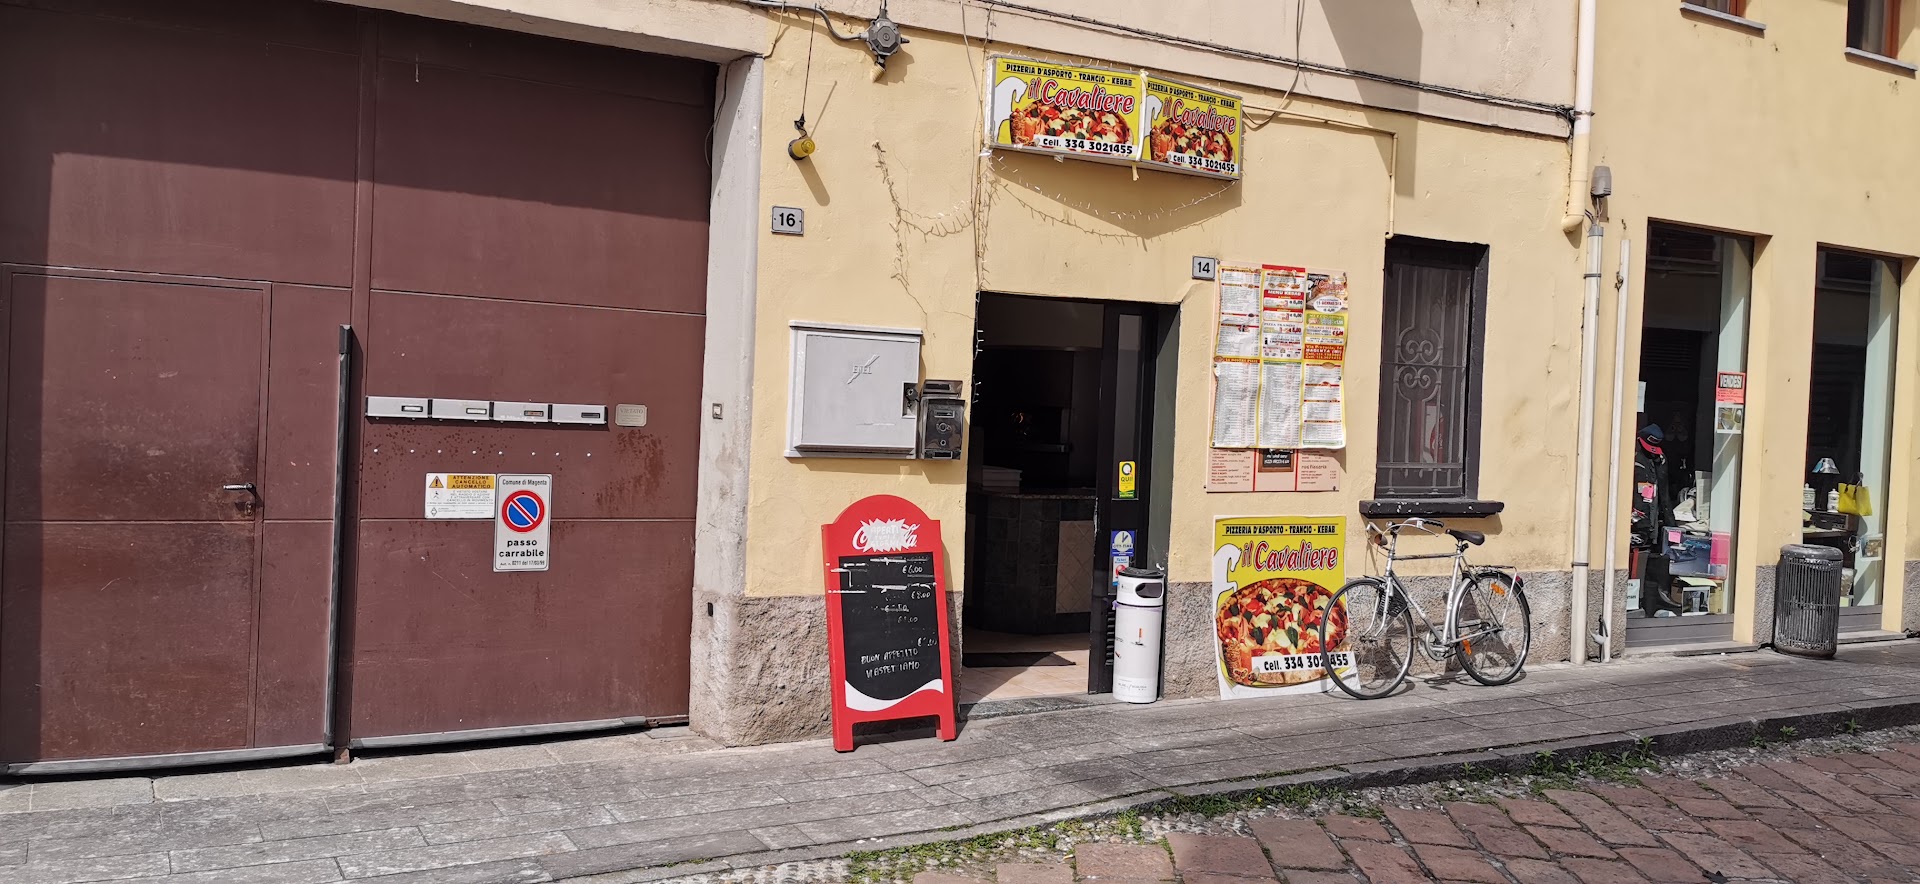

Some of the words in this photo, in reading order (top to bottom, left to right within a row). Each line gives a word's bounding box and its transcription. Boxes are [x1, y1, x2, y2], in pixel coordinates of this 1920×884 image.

[1006, 64, 1035, 74] PIZZERIA
[1038, 68, 1072, 79] D'ASPORTO
[1079, 73, 1106, 83] TRANCIO
[1112, 78, 1132, 86] KEBAB
[1028, 77, 1042, 100] il
[1042, 79, 1135, 114] Cavaliere
[1148, 82, 1168, 94] PIZZERIA
[1170, 88, 1194, 99] D'ASPORTO
[1198, 94, 1216, 104] TRANCIO
[1220, 100, 1235, 108] KEBAB
[1162, 96, 1172, 118] il
[1172, 98, 1236, 135] Cavaliere
[1043, 138, 1062, 148] Cell.
[1065, 138, 1084, 150] 334
[1089, 142, 1132, 154] 3021455
[1173, 154, 1186, 164] Cell.
[1188, 156, 1202, 166] 334
[1205, 160, 1235, 172] 3021455
[779, 212, 796, 227] 16
[1198, 262, 1210, 274] 14
[1720, 374, 1742, 388] VENDESI
[1226, 526, 1252, 534] PIZZERIA
[1253, 526, 1283, 534] D'ASPORTO
[499, 549, 544, 557] carrabile
[1242, 540, 1254, 567] il
[1254, 539, 1338, 571] Cavaliere
[861, 654, 880, 664] BUON
[884, 648, 918, 660] APPETITO
[1264, 660, 1282, 671] Cell.
[1284, 656, 1303, 670] 334
[1307, 654, 1348, 668] 302455
